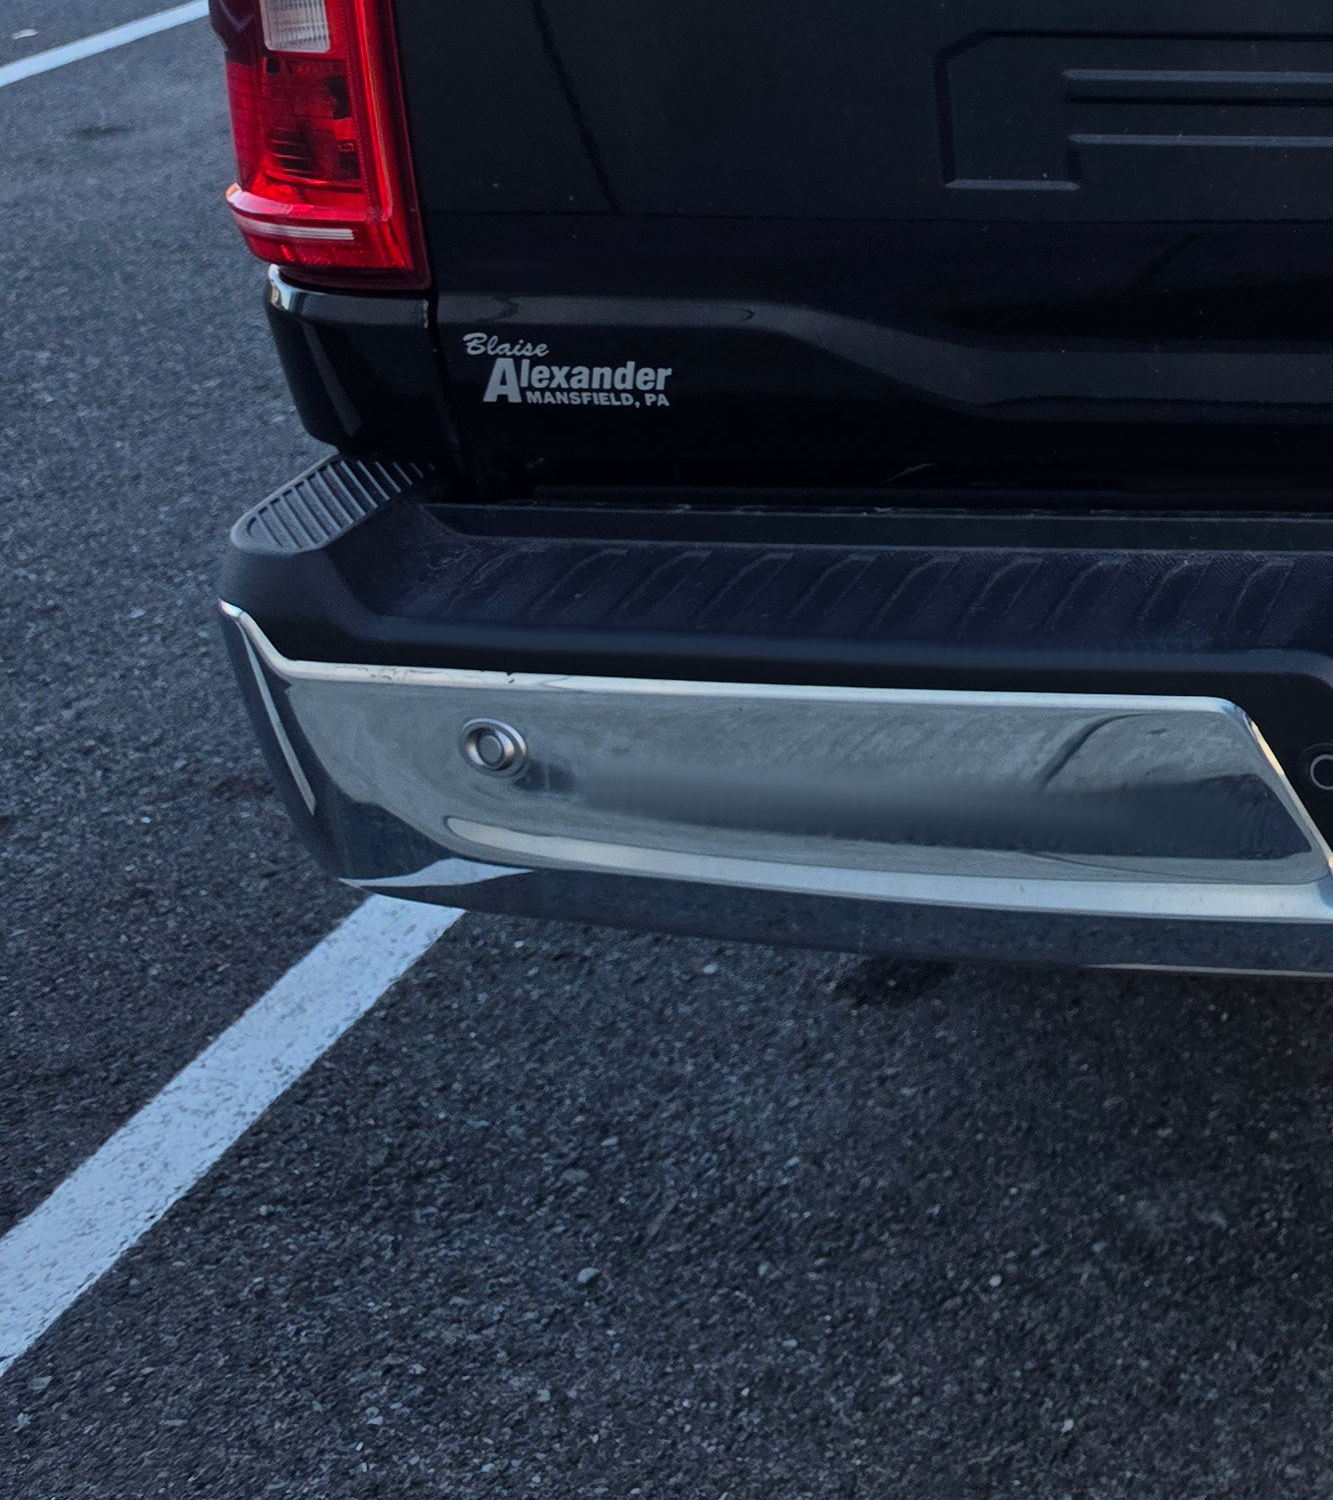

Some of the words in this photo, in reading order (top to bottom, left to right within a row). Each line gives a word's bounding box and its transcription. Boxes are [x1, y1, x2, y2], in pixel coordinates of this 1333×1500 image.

[463, 332, 549, 357] Blaise
[483, 358, 672, 403] Alexander
[525, 390, 641, 408] MANSFIELD,
[645, 393, 670, 407] PA
